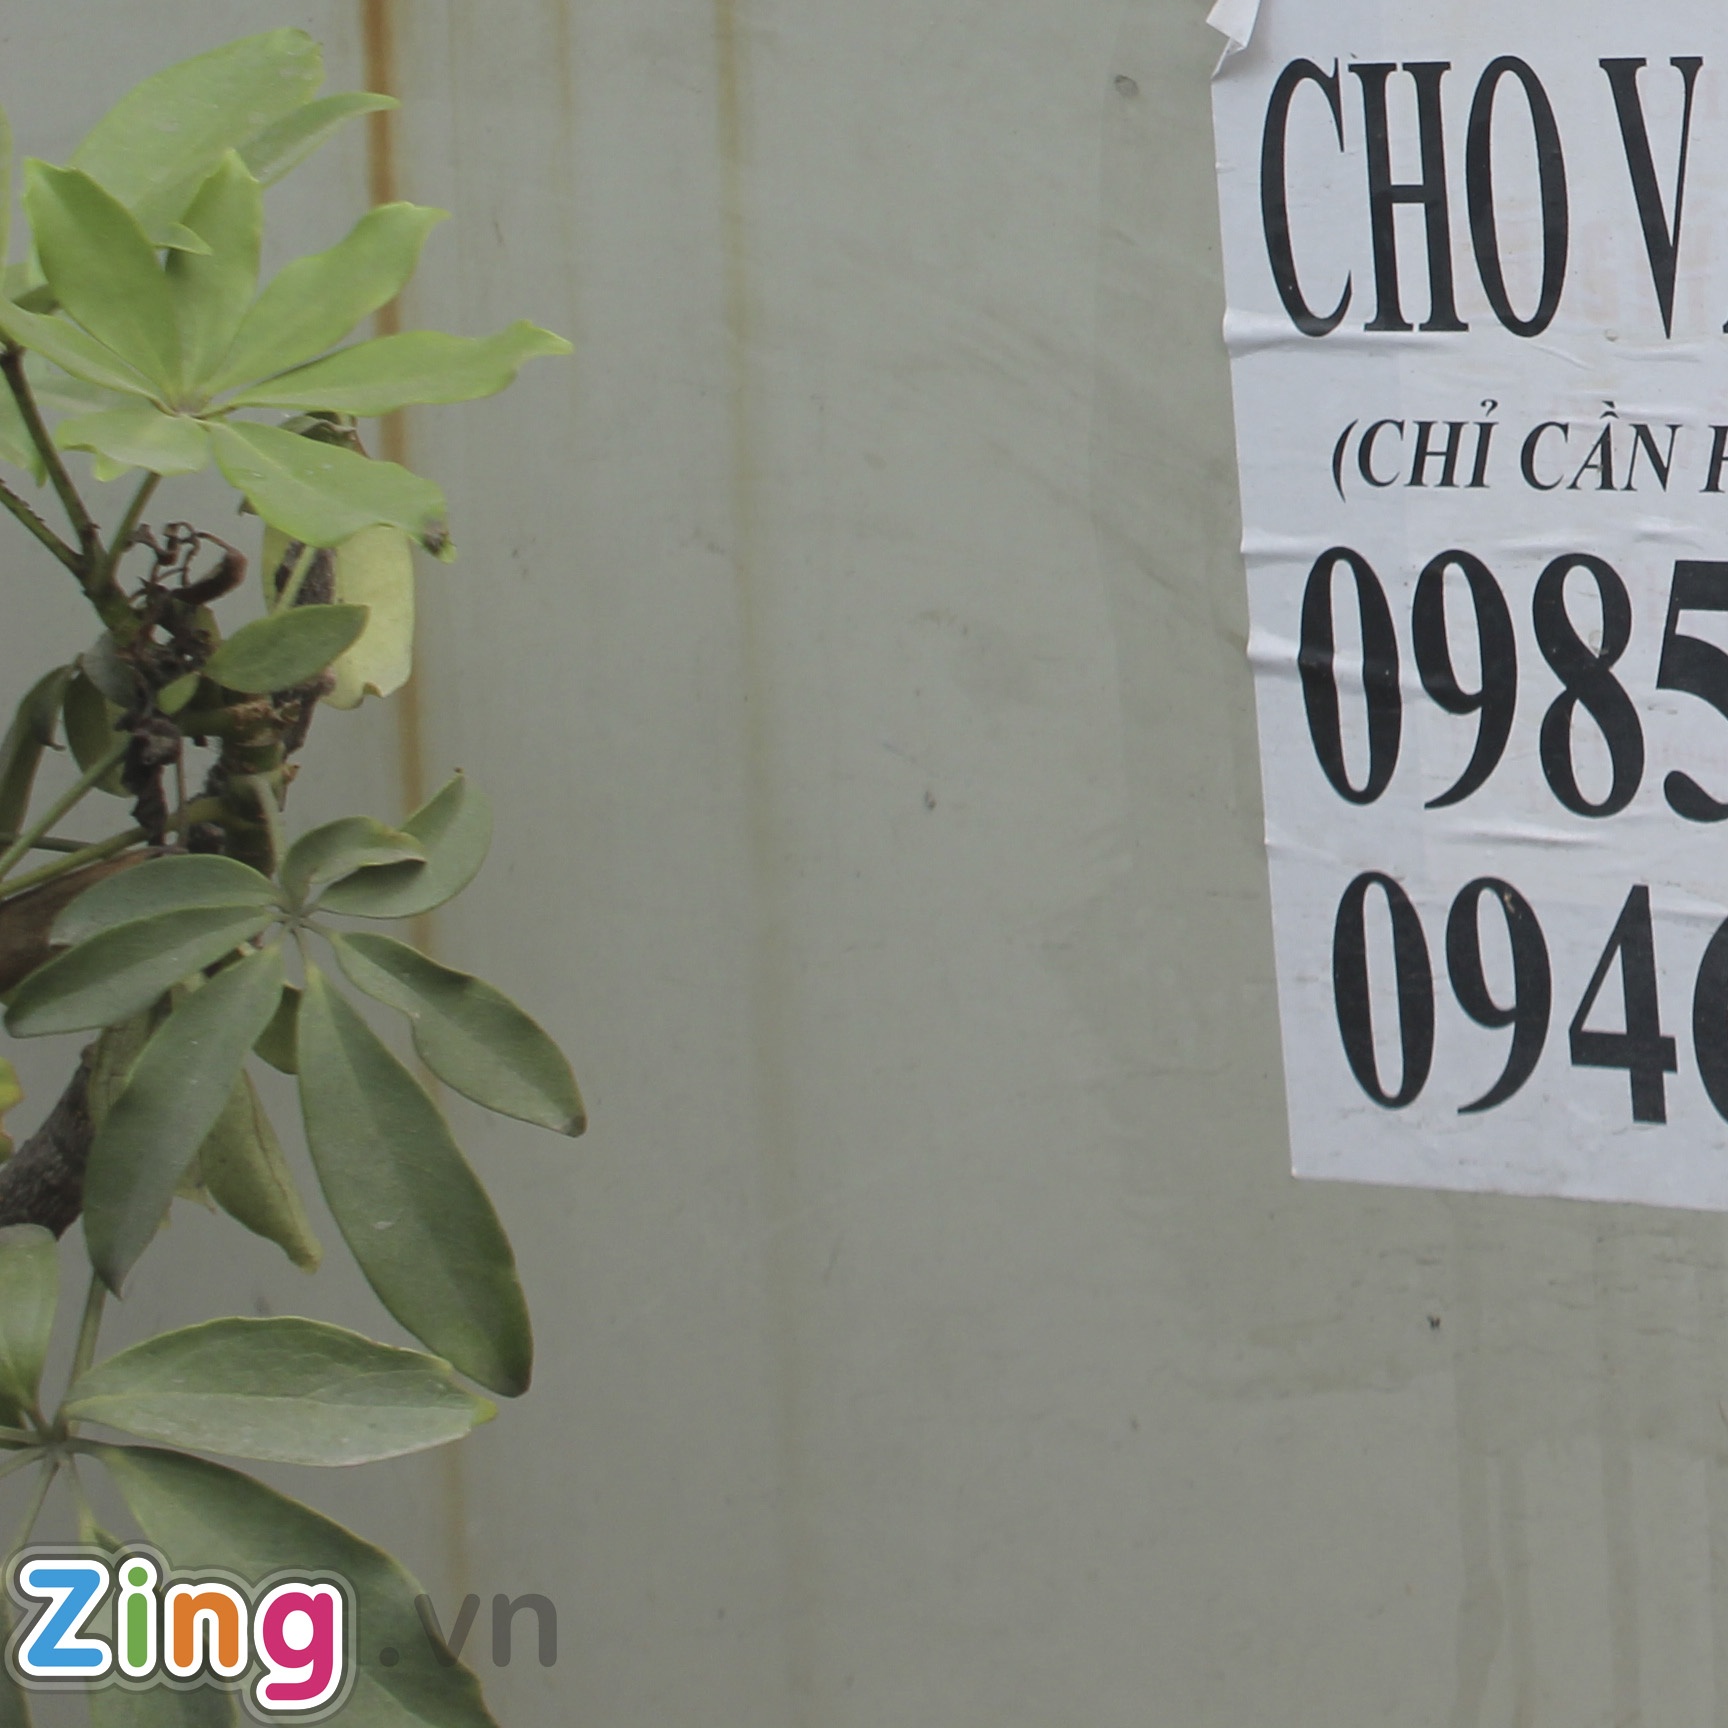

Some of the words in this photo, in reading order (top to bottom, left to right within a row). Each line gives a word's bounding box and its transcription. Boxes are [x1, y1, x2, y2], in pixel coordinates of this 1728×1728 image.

[1259, 55, 1569, 338] CHO
[1332, 399, 1498, 502] (CHỈ
[1519, 401, 1683, 494] CẦN
